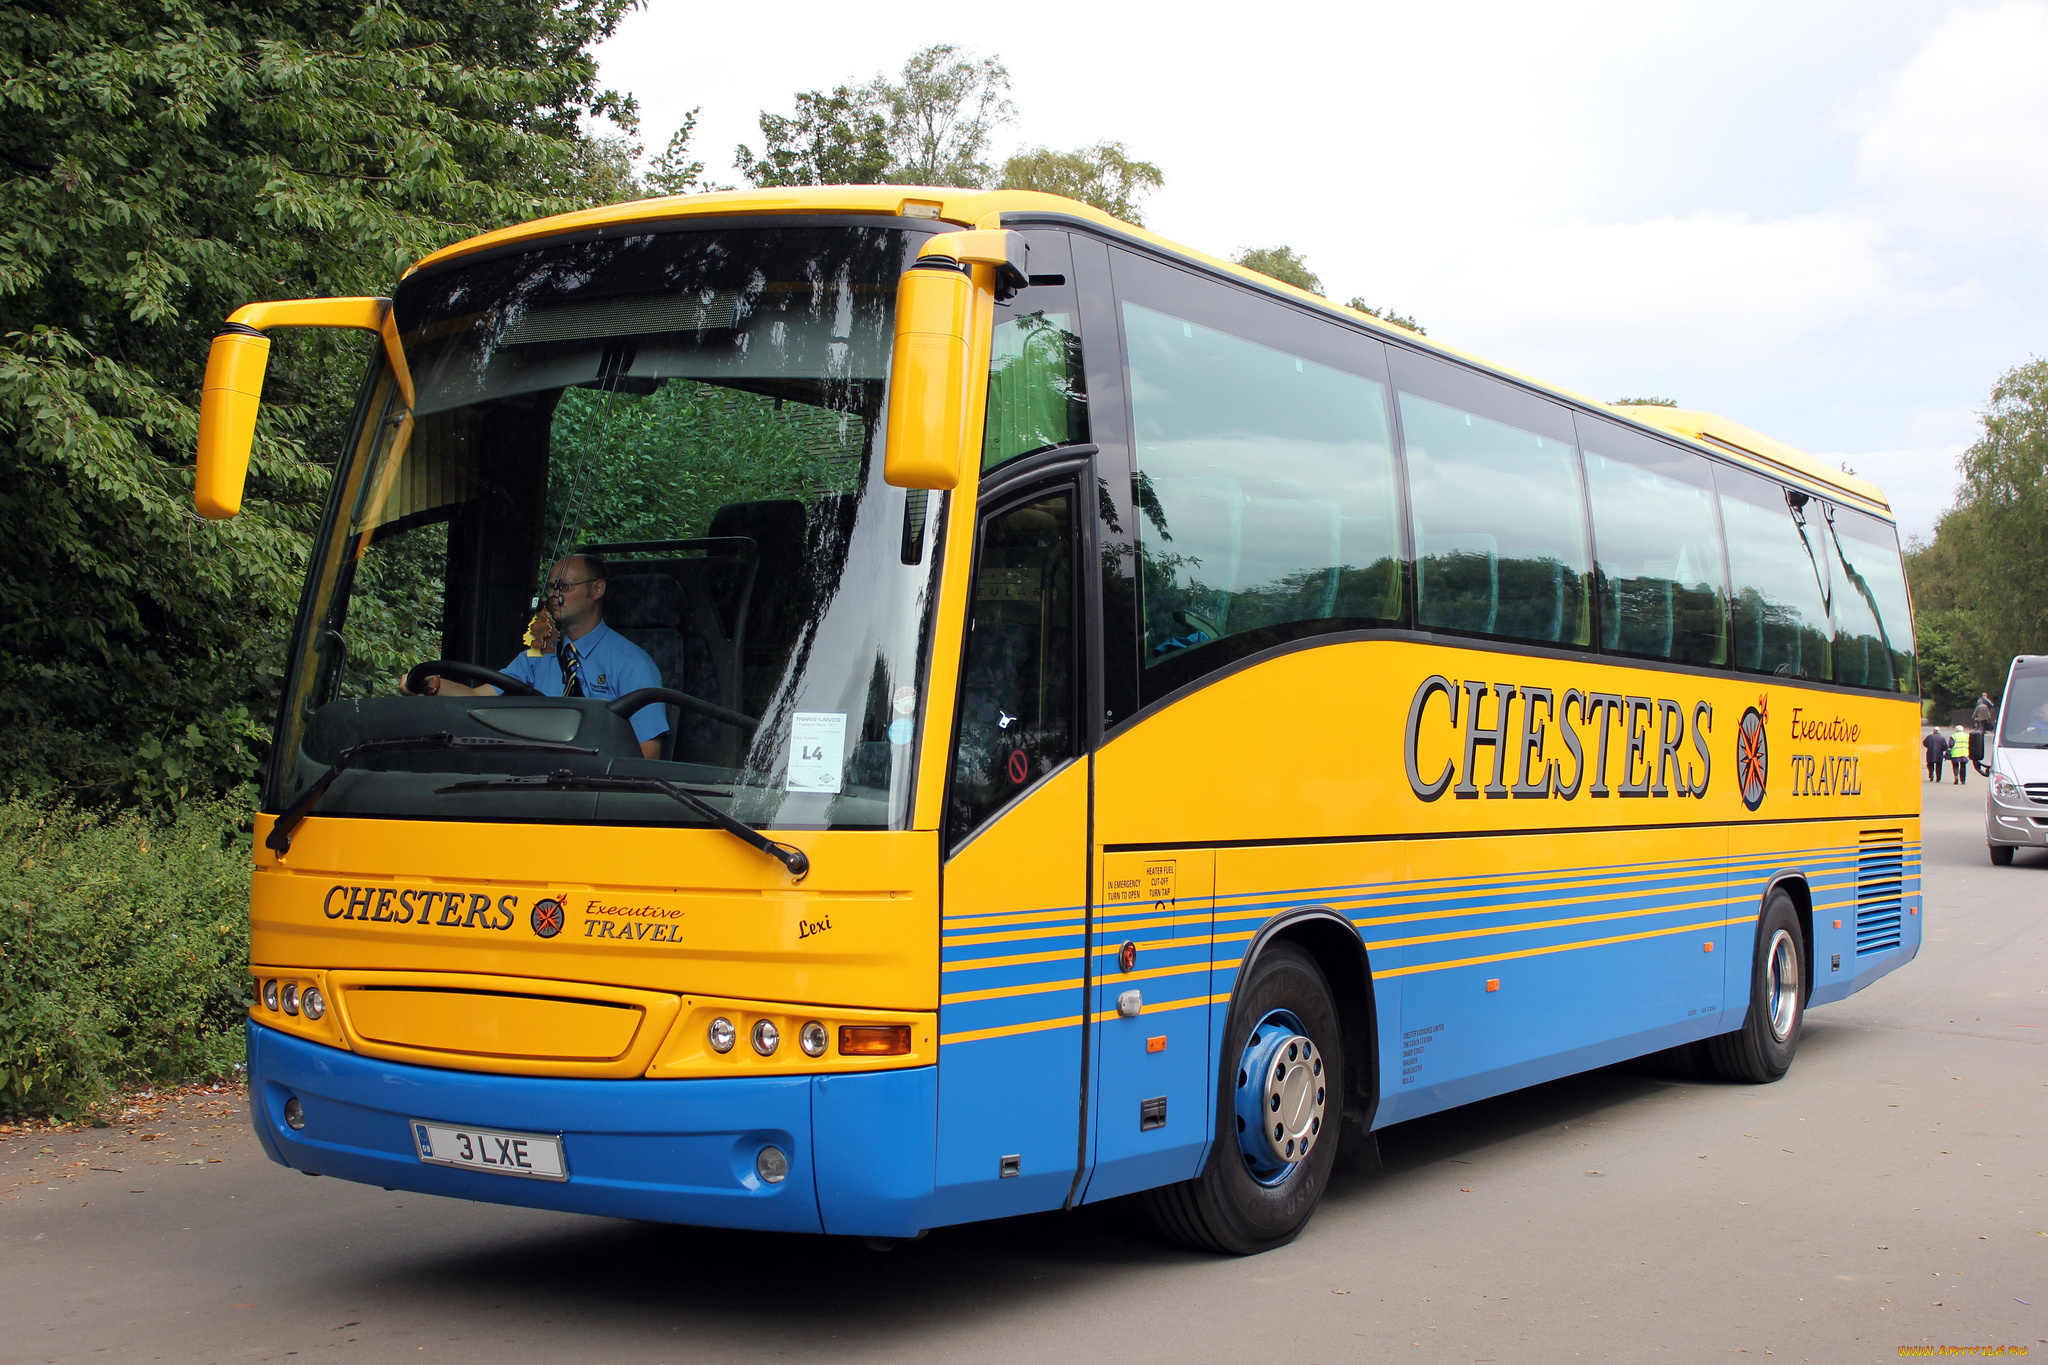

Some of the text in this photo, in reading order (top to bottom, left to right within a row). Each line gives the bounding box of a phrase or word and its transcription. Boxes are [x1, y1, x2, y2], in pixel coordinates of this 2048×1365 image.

[1791, 707, 1861, 742] Executive
[1404, 674, 1712, 802] CHESTERS
[802, 745, 823, 760] L4
[1791, 754, 1861, 796] TRAVEL
[1146, 866, 1173, 875] HEATER FUEL
[1108, 879, 1141, 889] IN EMERGENCY
[1151, 877, 1169, 886] CUT-OFF
[1108, 890, 1140, 900] TURN TO OPEN
[1149, 888, 1170, 897] TURN TAP
[323, 885, 518, 931] CHESTERS
[586, 900, 685, 919] Executive
[584, 919, 683, 942] TRAVEL
[799, 914, 833, 939] Lexi
[422, 1144, 431, 1153] GB
[456, 1133, 532, 1168] 3 LXE
